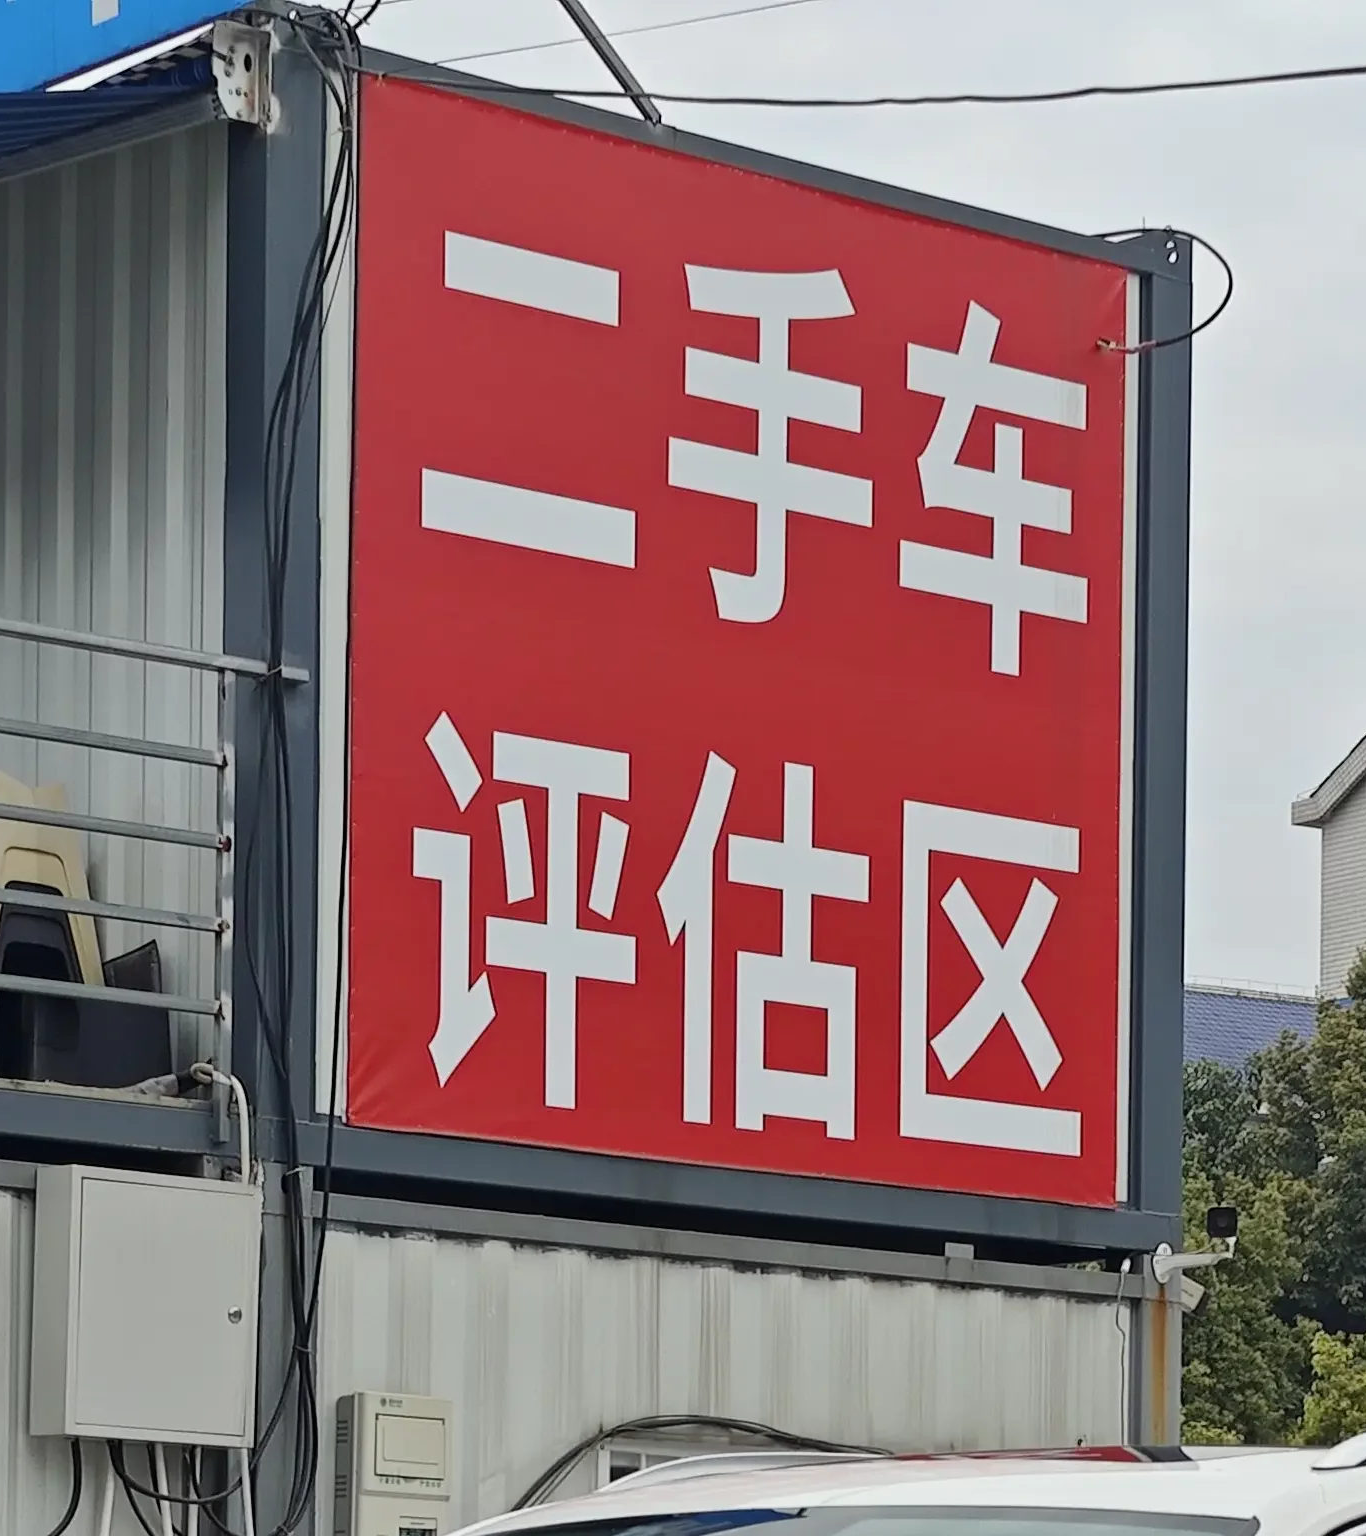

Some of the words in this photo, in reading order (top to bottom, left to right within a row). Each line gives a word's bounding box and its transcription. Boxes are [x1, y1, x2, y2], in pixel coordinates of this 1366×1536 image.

[421, 229, 1089, 677] 二手车
[412, 710, 1082, 1158] 评估区
